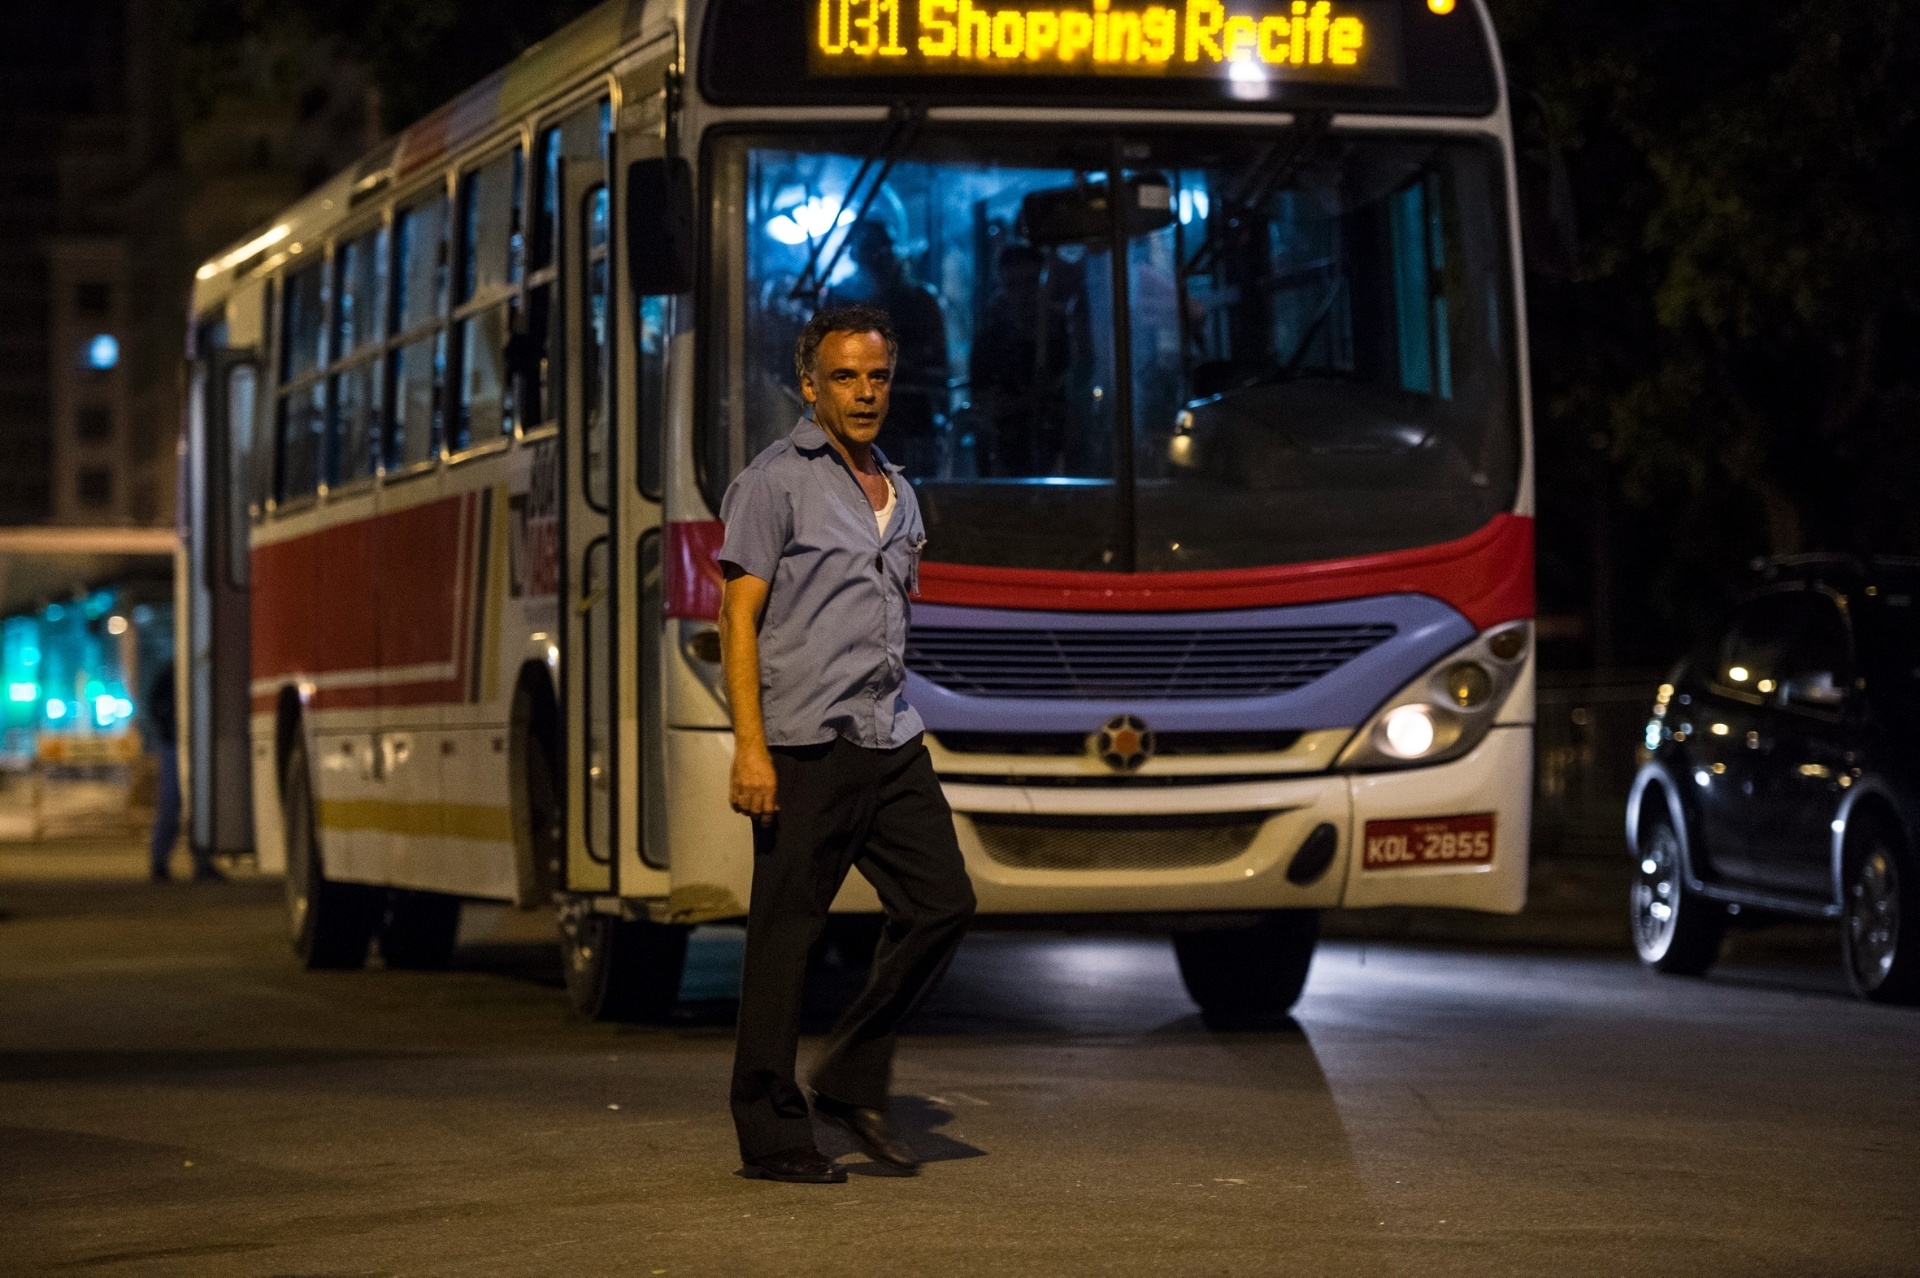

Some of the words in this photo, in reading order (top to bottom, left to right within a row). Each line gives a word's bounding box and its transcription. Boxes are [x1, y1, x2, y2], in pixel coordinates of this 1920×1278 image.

[819, 0, 907, 55] 031
[918, 0, 1176, 62] Shopping
[1184, 0, 1364, 65] Recife
